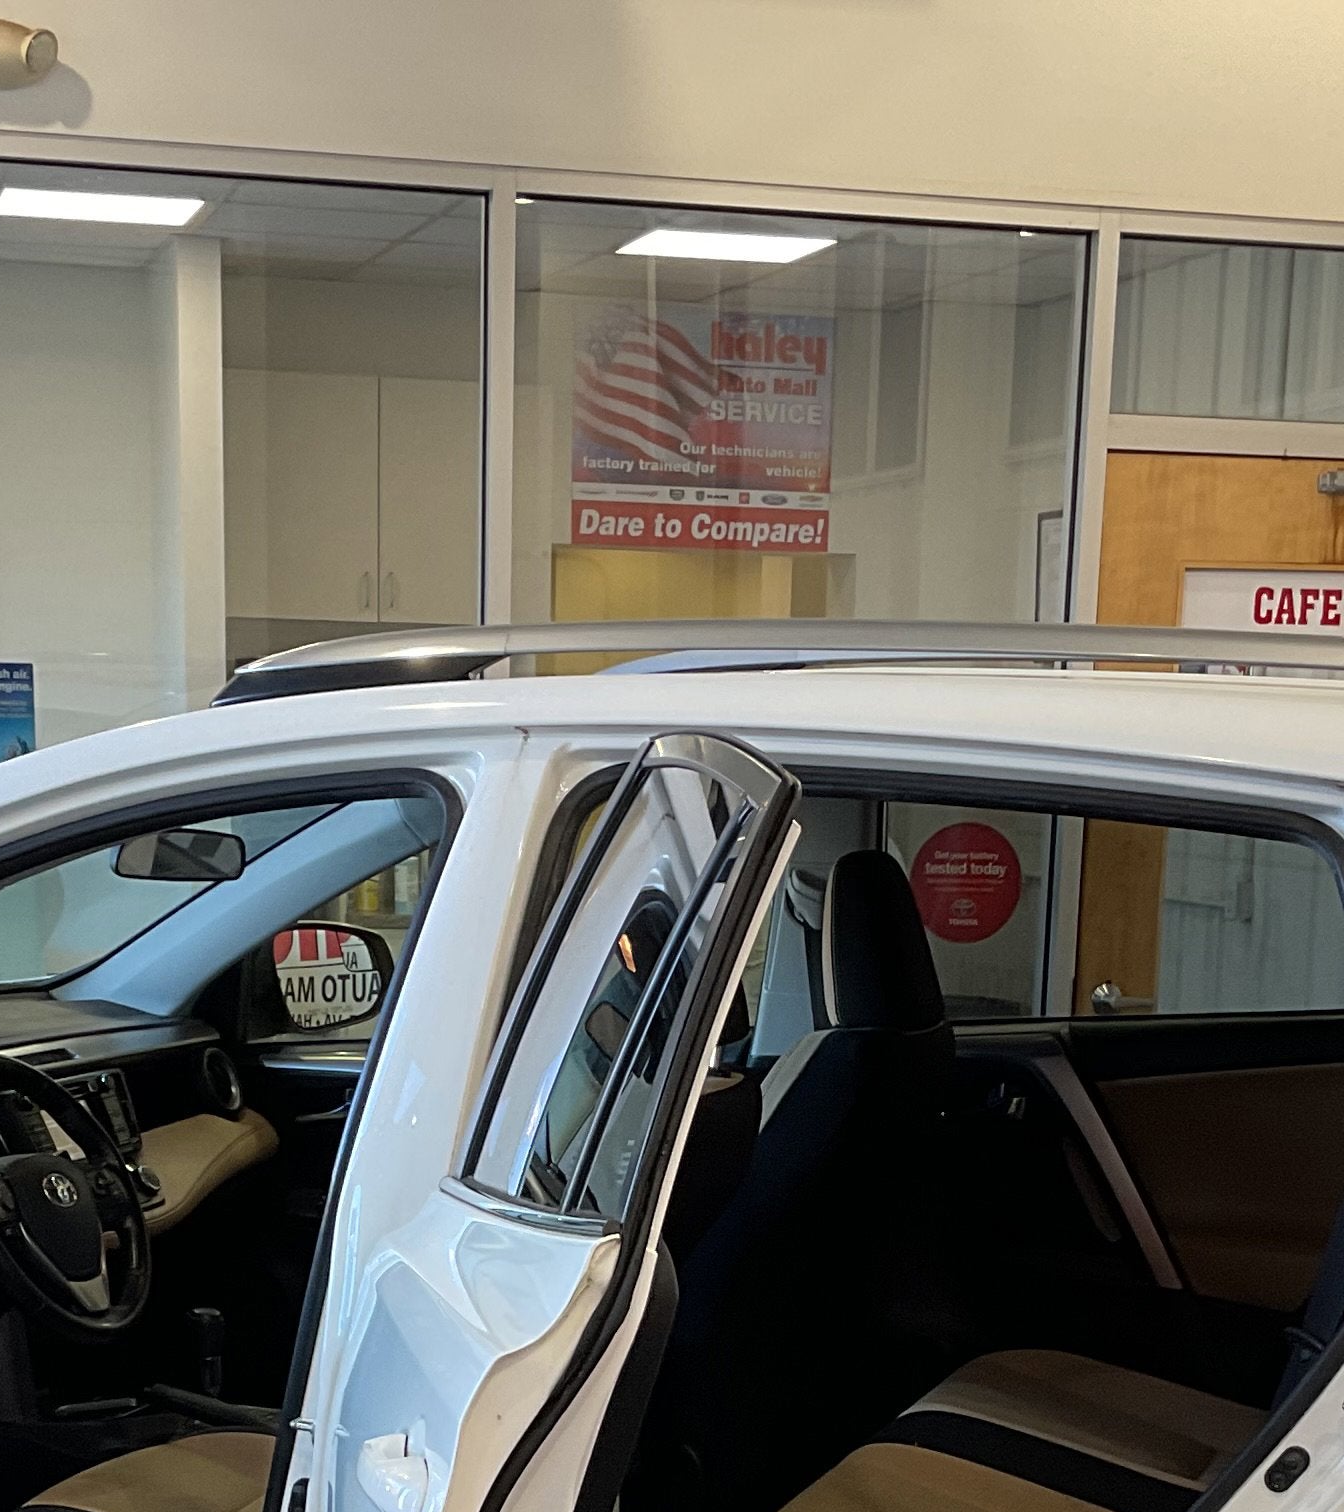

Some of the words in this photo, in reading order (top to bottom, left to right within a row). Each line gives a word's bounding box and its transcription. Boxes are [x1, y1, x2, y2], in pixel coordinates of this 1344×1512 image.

[711, 320, 828, 375] haley
[773, 378, 817, 396] Mall
[710, 400, 823, 425] SERVICE
[680, 442, 706, 455] Our
[711, 444, 794, 459] technicians
[582, 456, 634, 474] factory
[639, 457, 692, 474] trained
[696, 460, 717, 477] for
[766, 465, 823, 479] vehicle!
[579, 508, 645, 537] Dare
[654, 512, 682, 539] to
[691, 512, 825, 548] Compare!
[1253, 586, 1343, 626] CAFE
[925, 862, 968, 875] tested
[970, 862, 1009, 879] today
